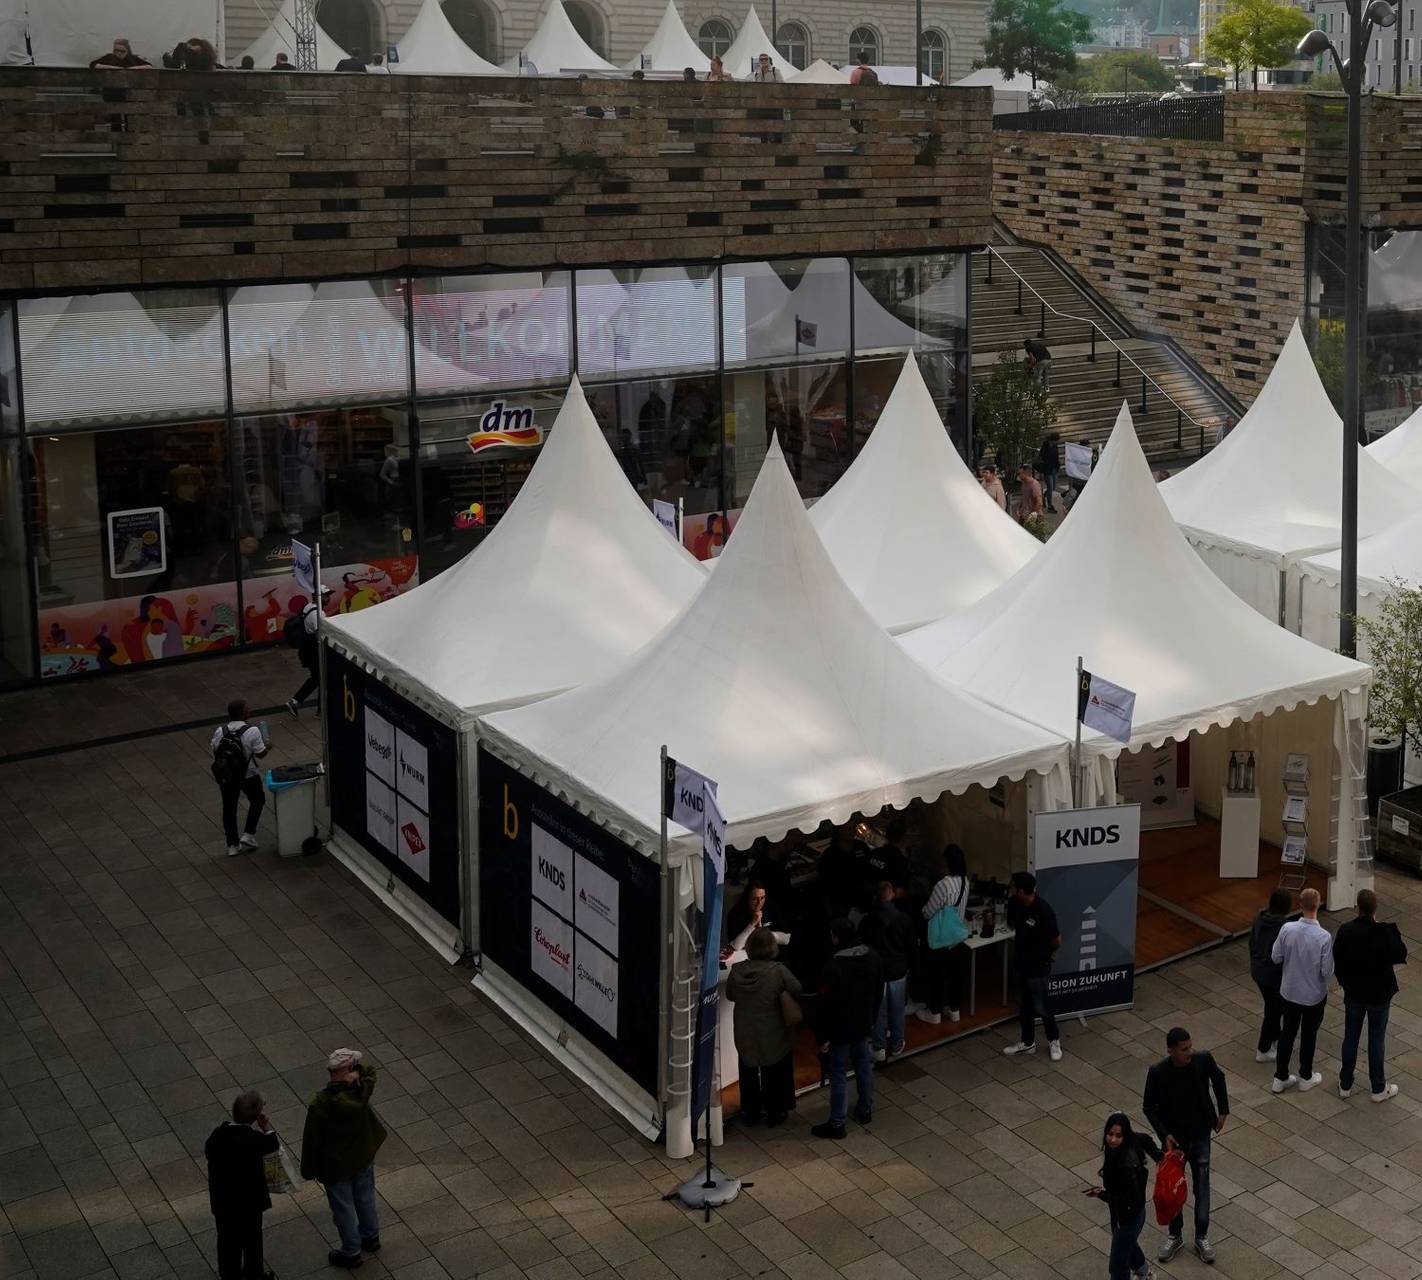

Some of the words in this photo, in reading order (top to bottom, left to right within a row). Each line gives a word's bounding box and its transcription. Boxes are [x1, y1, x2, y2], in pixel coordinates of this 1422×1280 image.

[482, 402, 533, 432] dm
[503, 783, 519, 840] b
[680, 787, 704, 812] KND
[1056, 824, 1120, 849] KNDS
[538, 855, 566, 892] KNDS
[1079, 970, 1128, 986] ZUKUNFT
